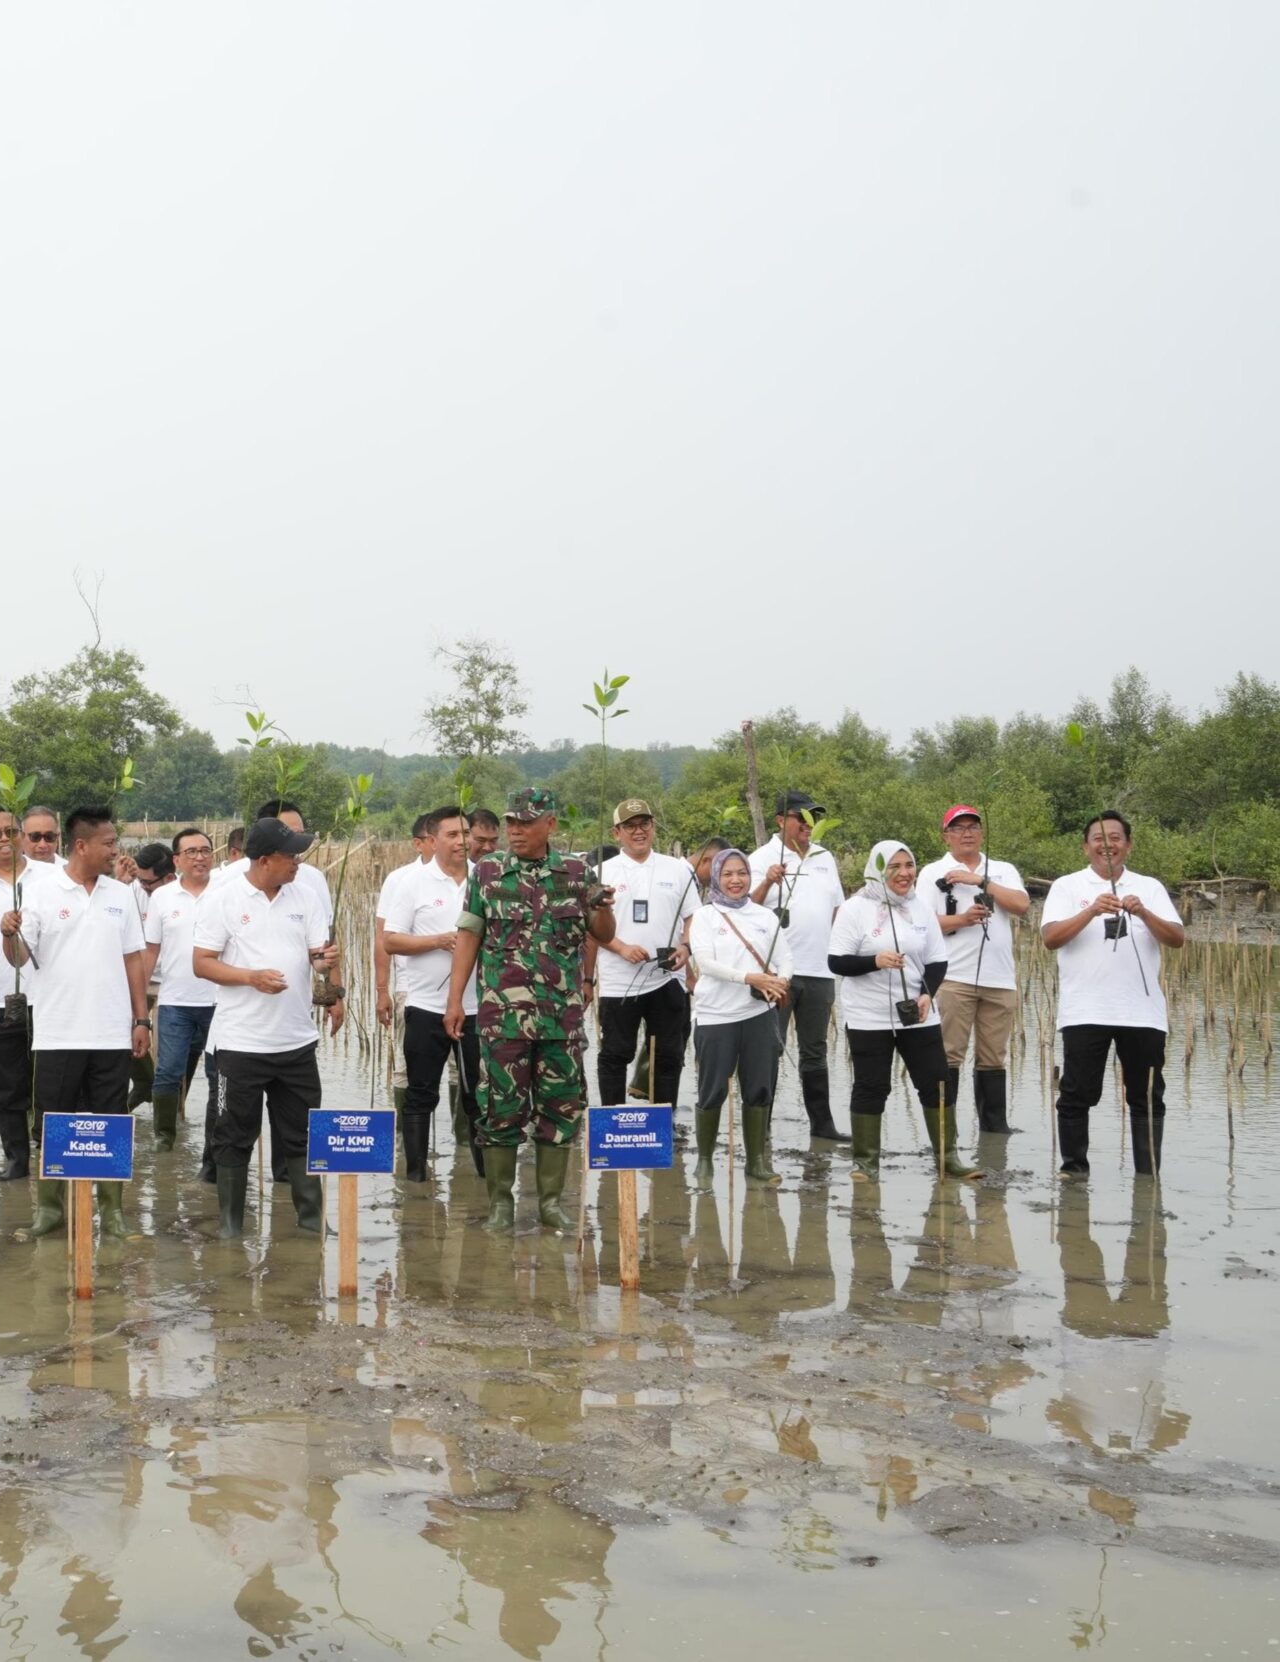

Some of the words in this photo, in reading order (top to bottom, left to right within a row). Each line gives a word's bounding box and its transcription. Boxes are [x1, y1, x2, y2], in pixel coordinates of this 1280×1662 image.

[327, 1135, 346, 1146] Dir
[347, 1135, 375, 1146] KMR
[605, 1132, 657, 1143] Danramil
[69, 1140, 107, 1151] Kades
